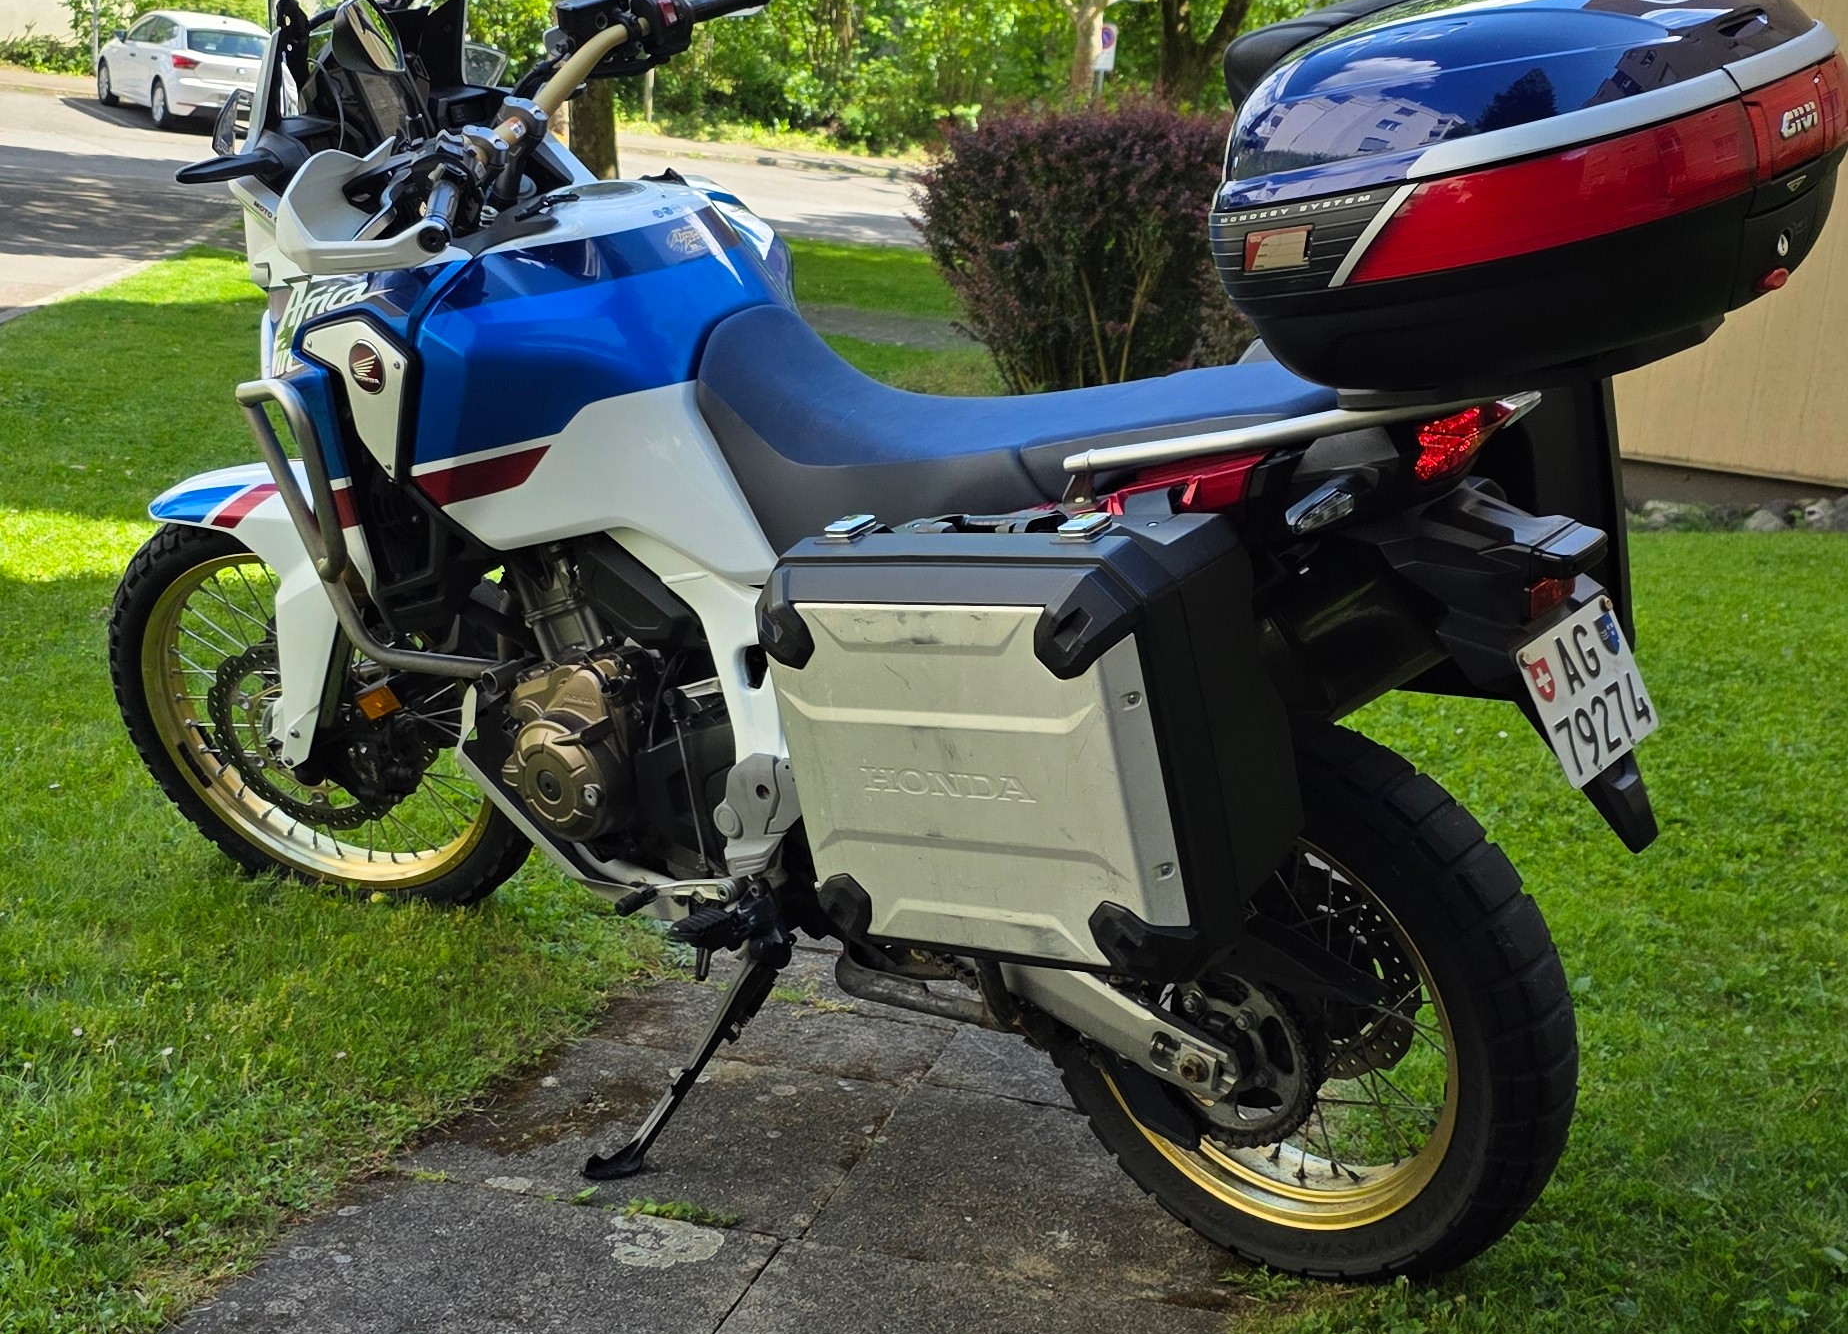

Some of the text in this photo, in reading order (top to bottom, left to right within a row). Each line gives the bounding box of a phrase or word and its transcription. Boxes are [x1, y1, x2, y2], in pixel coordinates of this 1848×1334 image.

[1780, 101, 1818, 138] GIVI
[254, 201, 273, 218] MOTO
[1220, 194, 1371, 224] MONOKEY SYSTEM
[280, 276, 394, 331] Africa
[1554, 624, 1601, 696] AG
[1553, 672, 1651, 776] 79274
[859, 766, 1037, 803] HONDA
